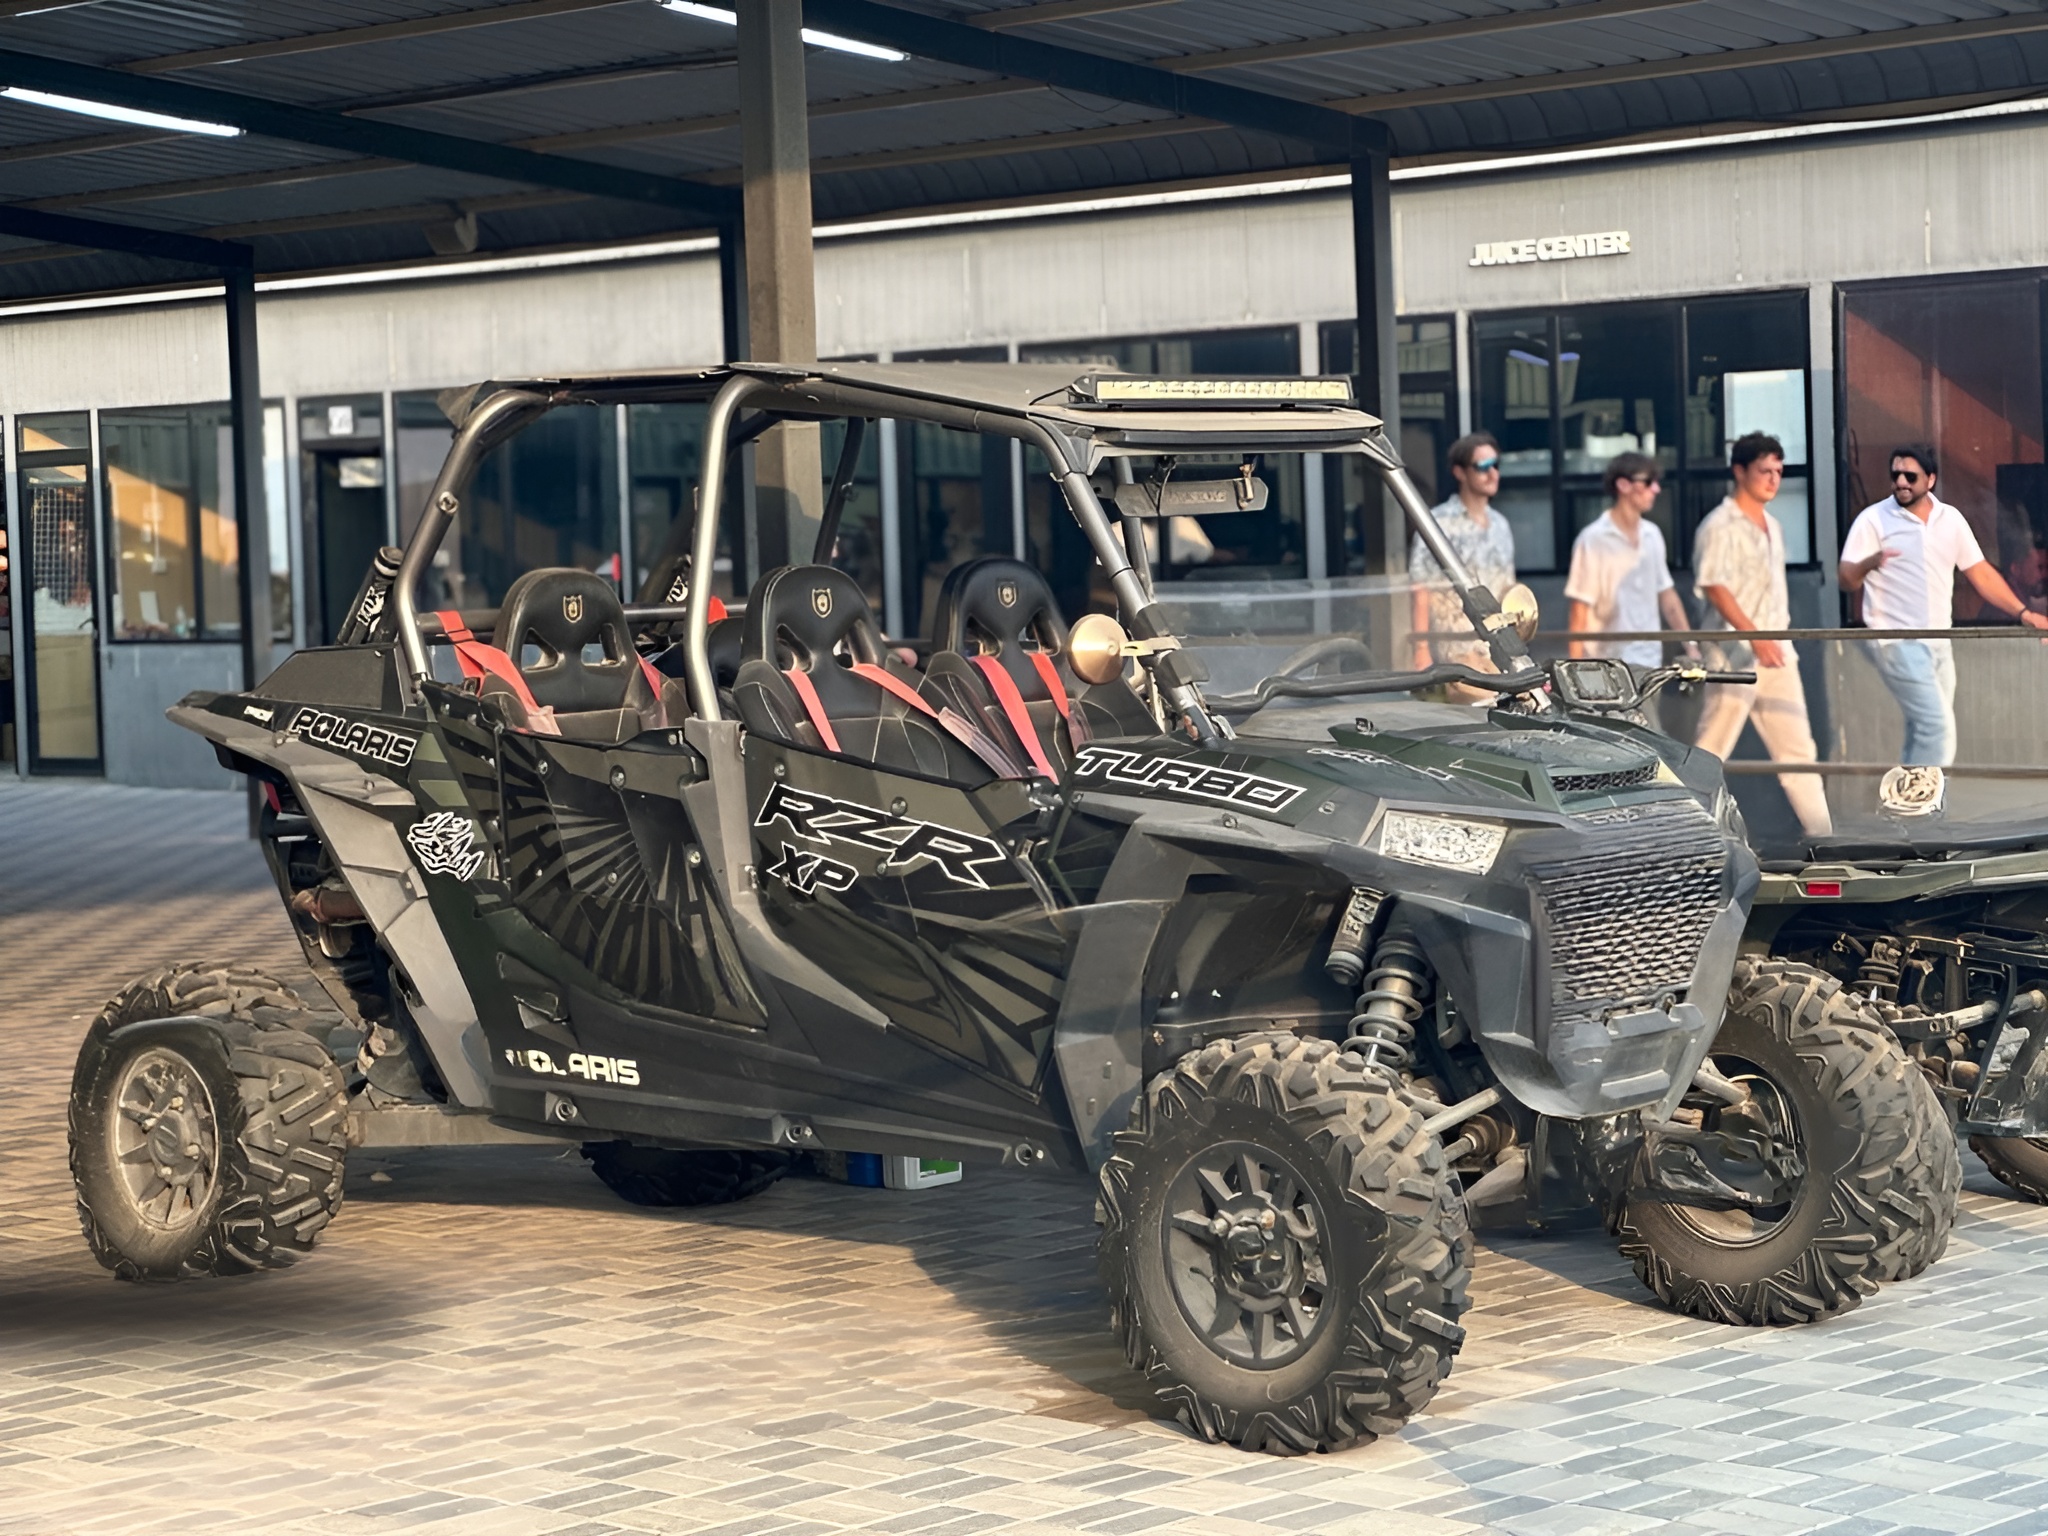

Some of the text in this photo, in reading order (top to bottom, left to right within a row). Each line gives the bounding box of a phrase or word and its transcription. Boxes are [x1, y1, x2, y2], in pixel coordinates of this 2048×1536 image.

[1469, 231, 1630, 266] JUICE CENTER
[289, 707, 417, 767] POLARIS
[1075, 747, 1307, 813] TURBO
[754, 782, 1006, 890] RZR
[766, 841, 859, 895] XP
